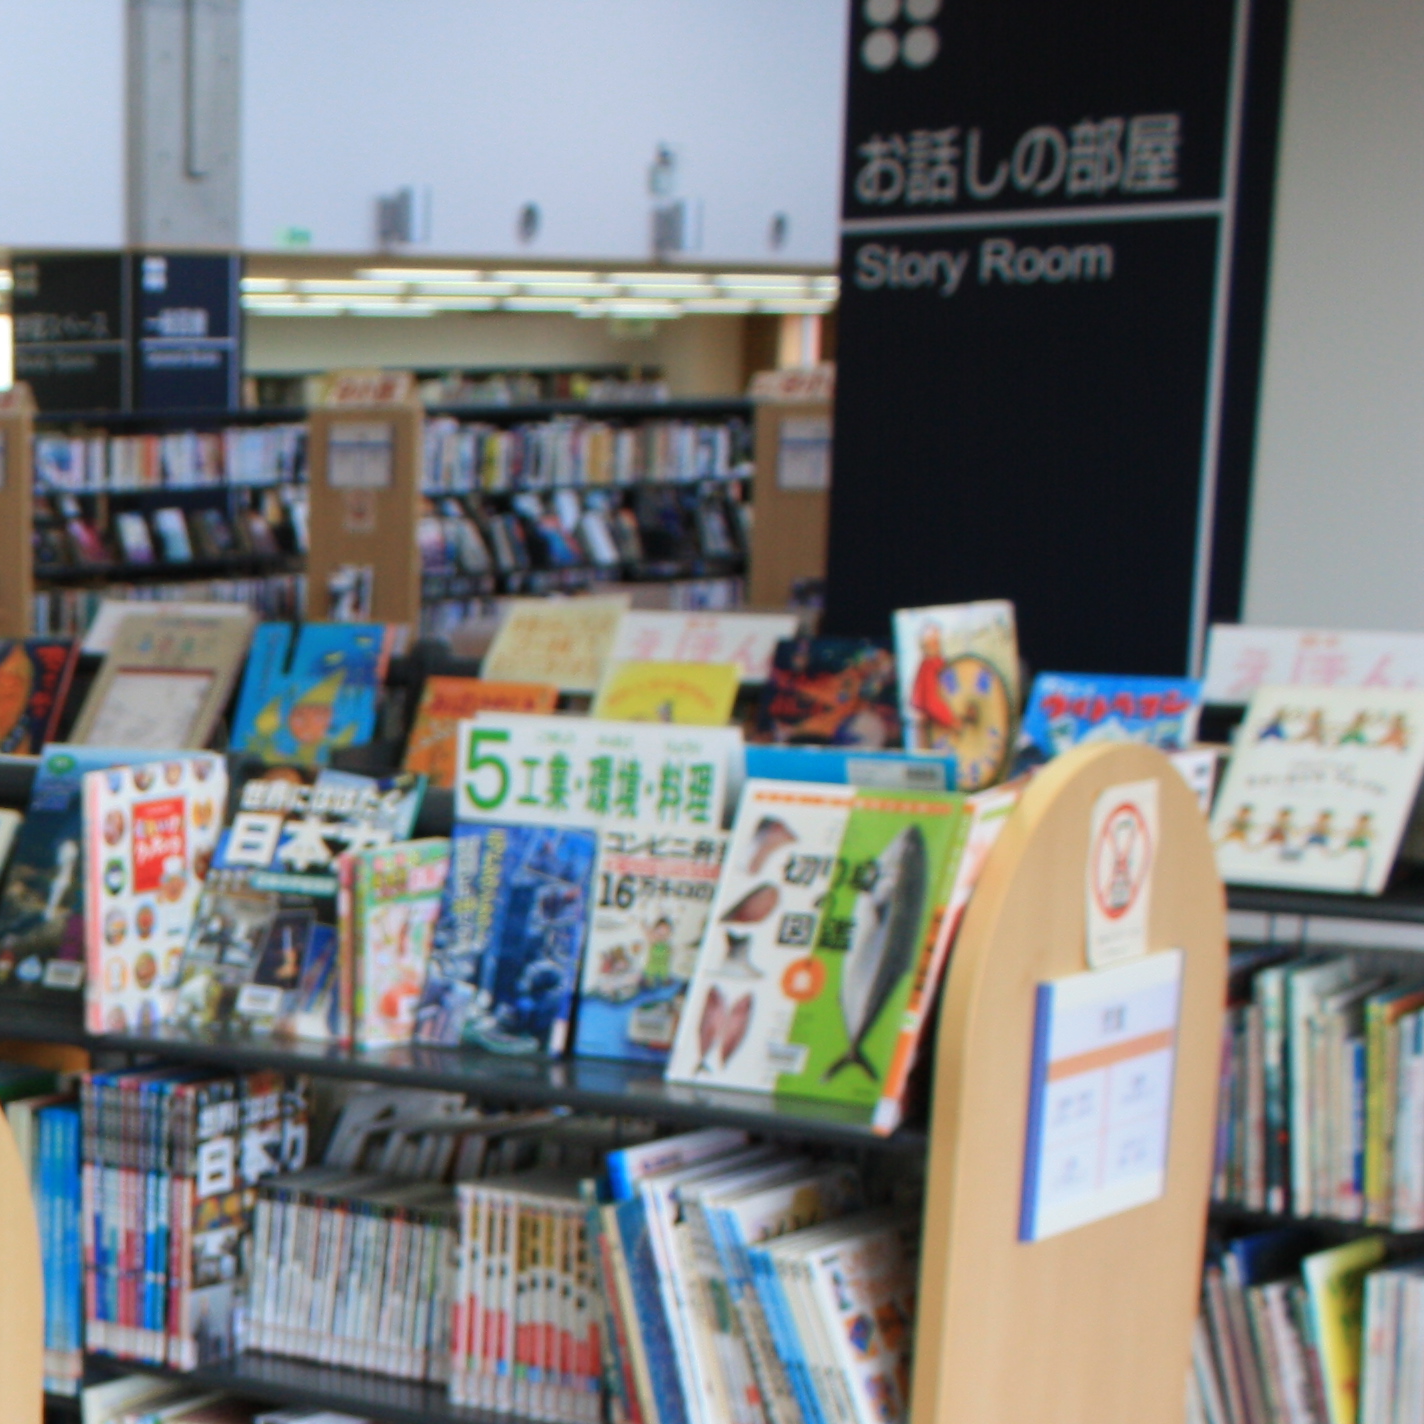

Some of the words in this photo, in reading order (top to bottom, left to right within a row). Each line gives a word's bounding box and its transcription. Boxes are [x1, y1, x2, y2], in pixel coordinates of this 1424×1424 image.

[854, 113, 1181, 204] お話しの部屋
[855, 241, 970, 297] Story
[979, 238, 1115, 285] Room
